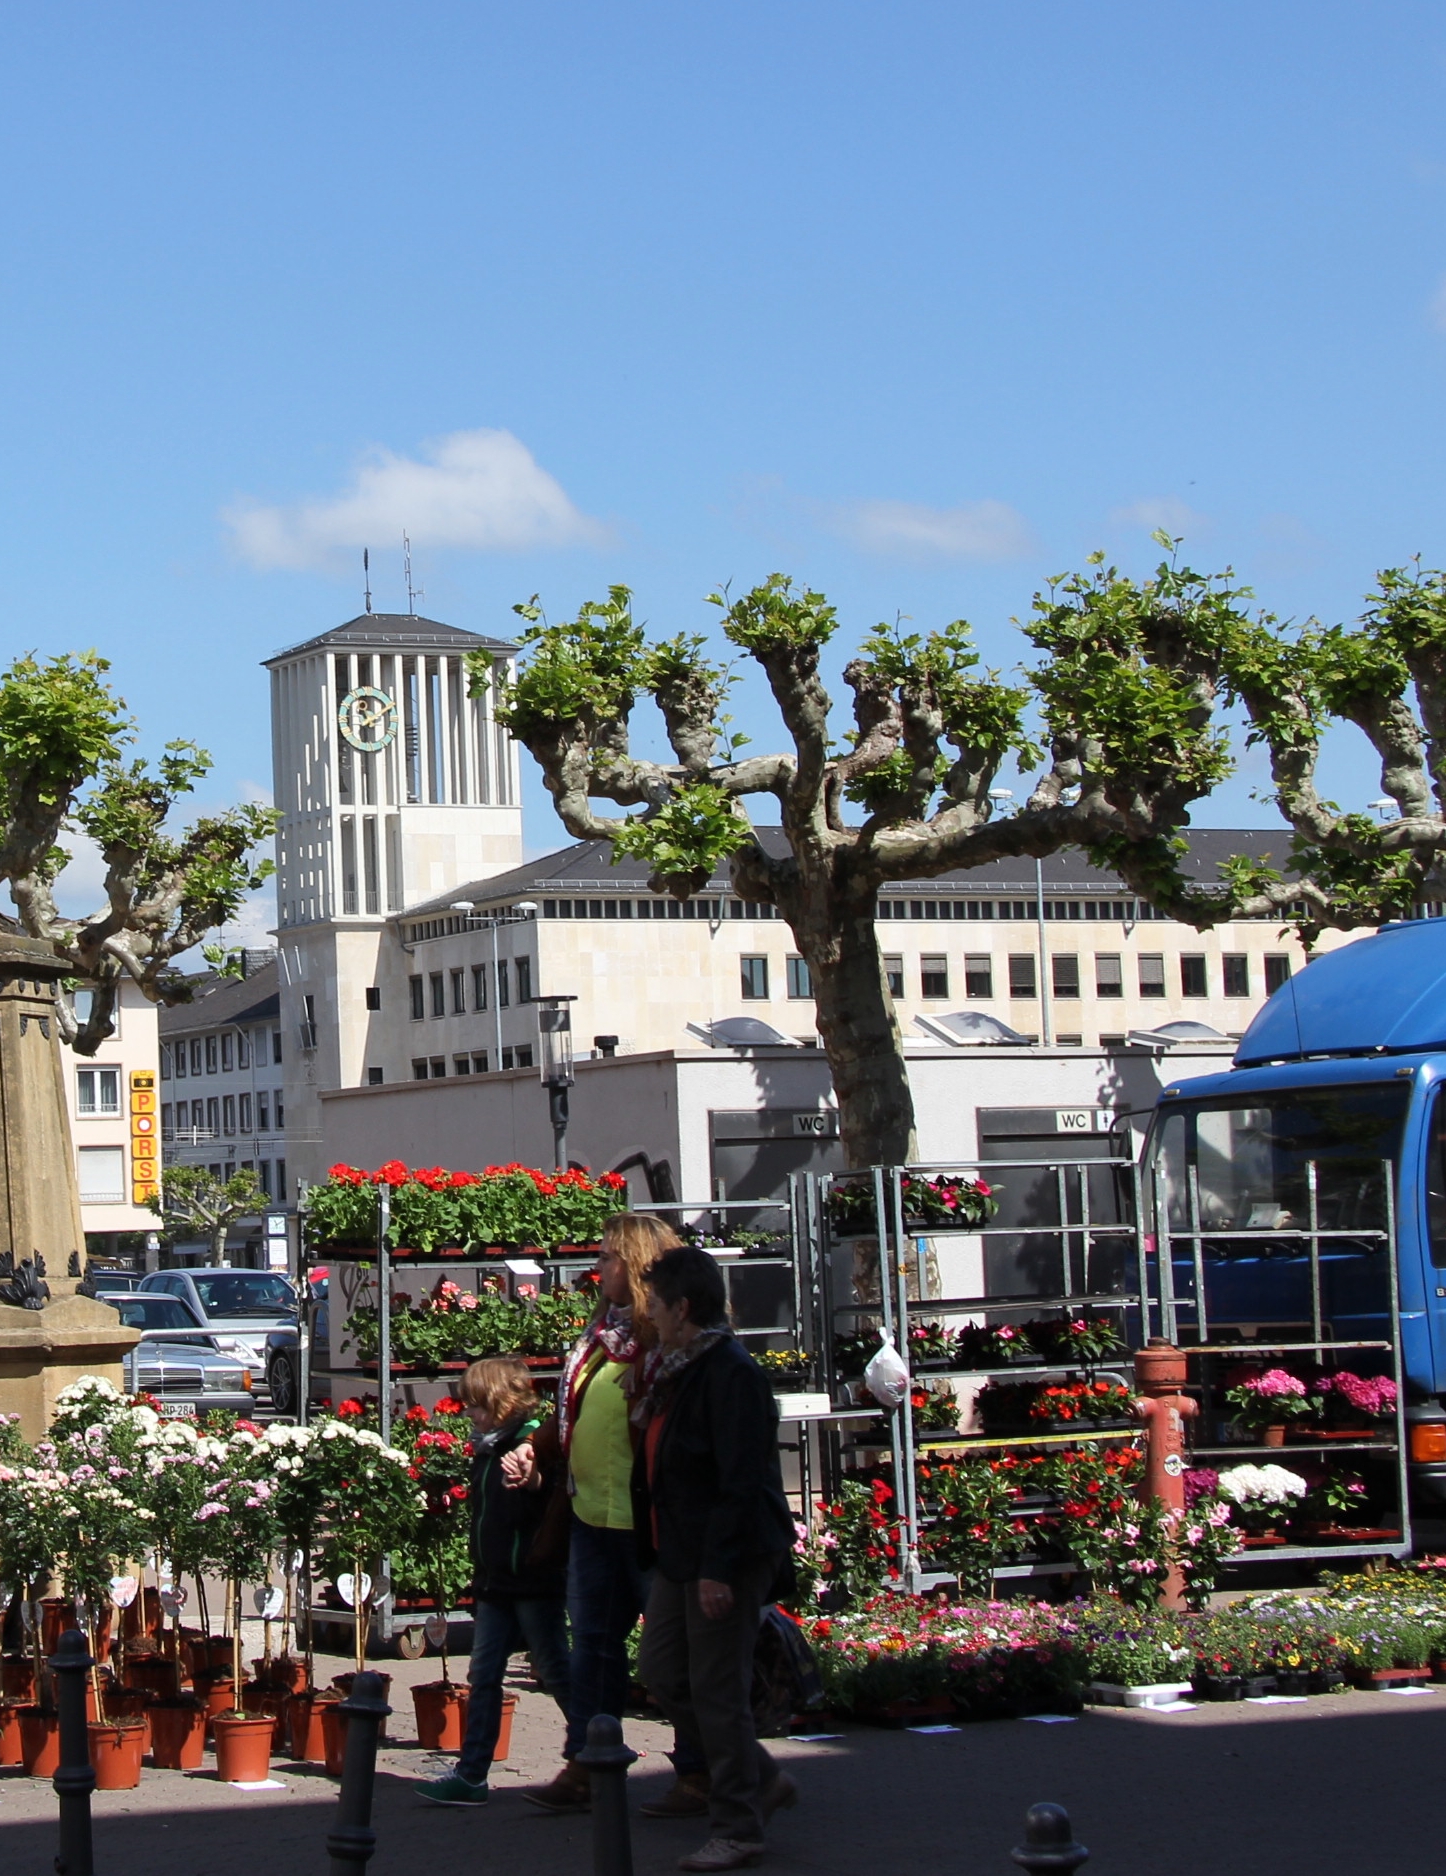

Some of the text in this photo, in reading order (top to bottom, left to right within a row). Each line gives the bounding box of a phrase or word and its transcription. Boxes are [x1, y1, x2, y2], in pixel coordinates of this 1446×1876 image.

[798, 1116, 825, 1132] WC
[1061, 1113, 1086, 1128] WC
[137, 1093, 153, 1201] PORST
